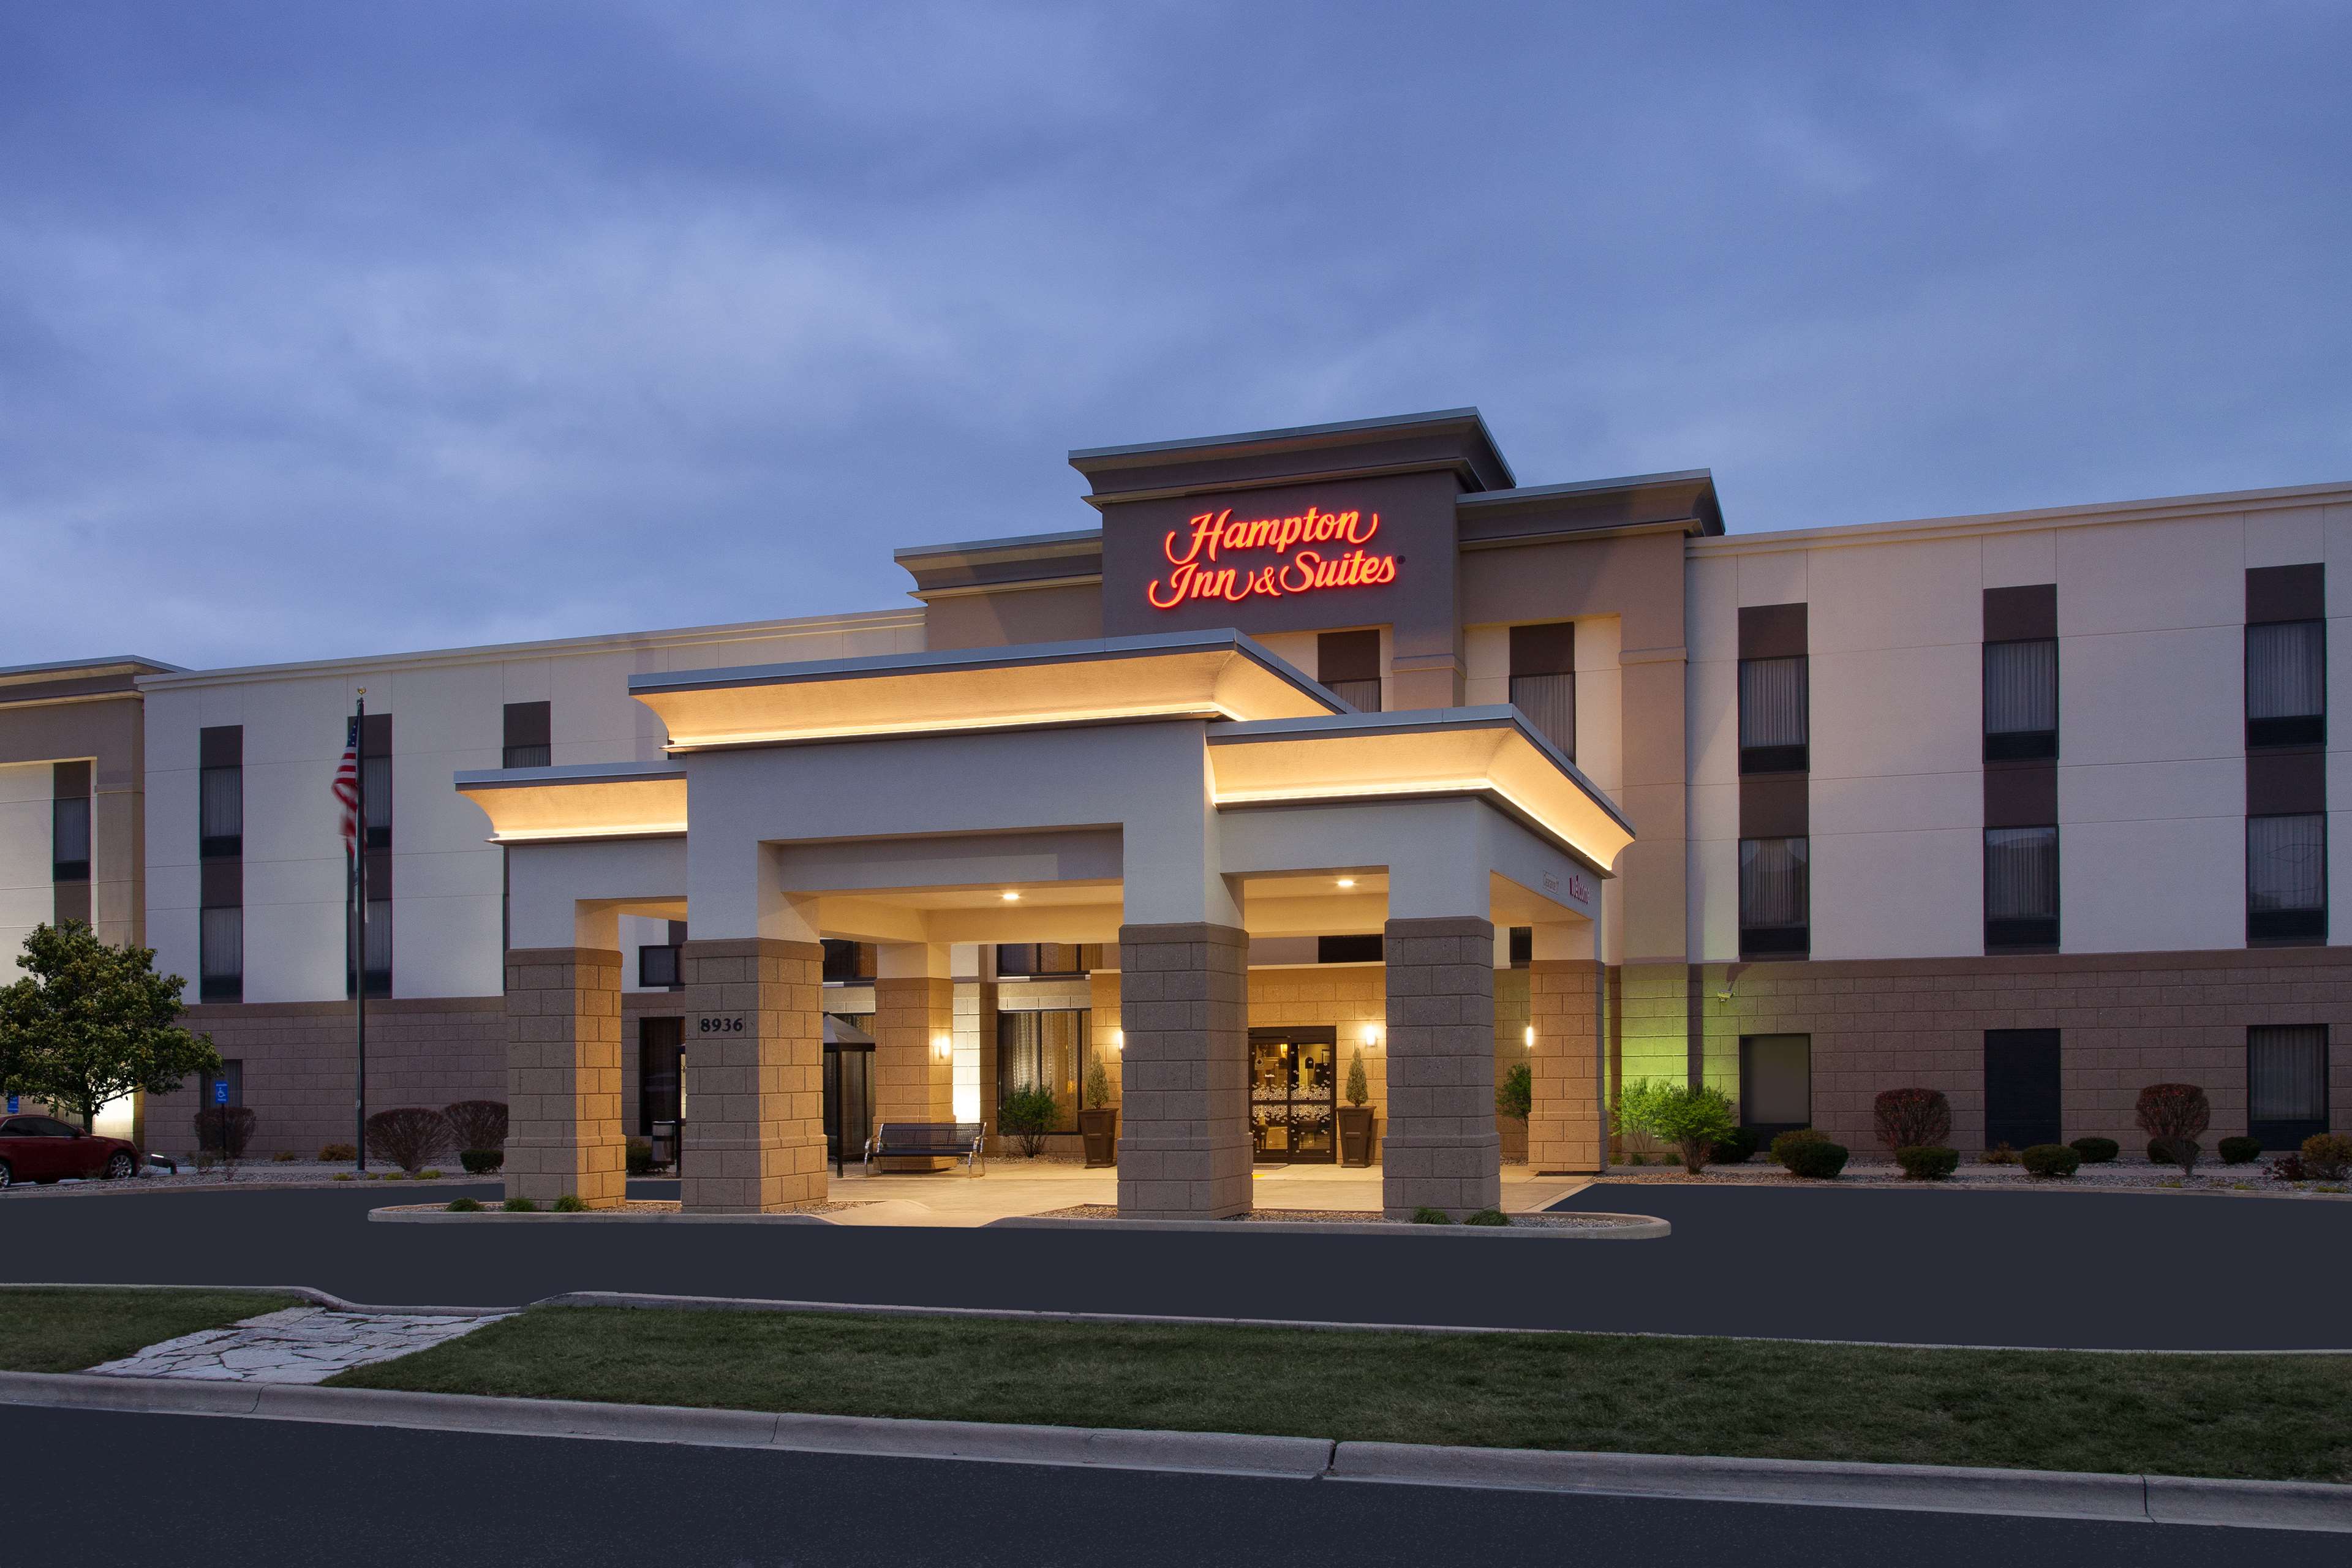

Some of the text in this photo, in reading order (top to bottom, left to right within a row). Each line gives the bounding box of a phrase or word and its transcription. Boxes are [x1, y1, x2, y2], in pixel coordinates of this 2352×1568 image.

[1165, 506, 1379, 565] Hampton
[1148, 549, 1396, 608] Inn & Suites
[700, 1018, 743, 1032] 8936
